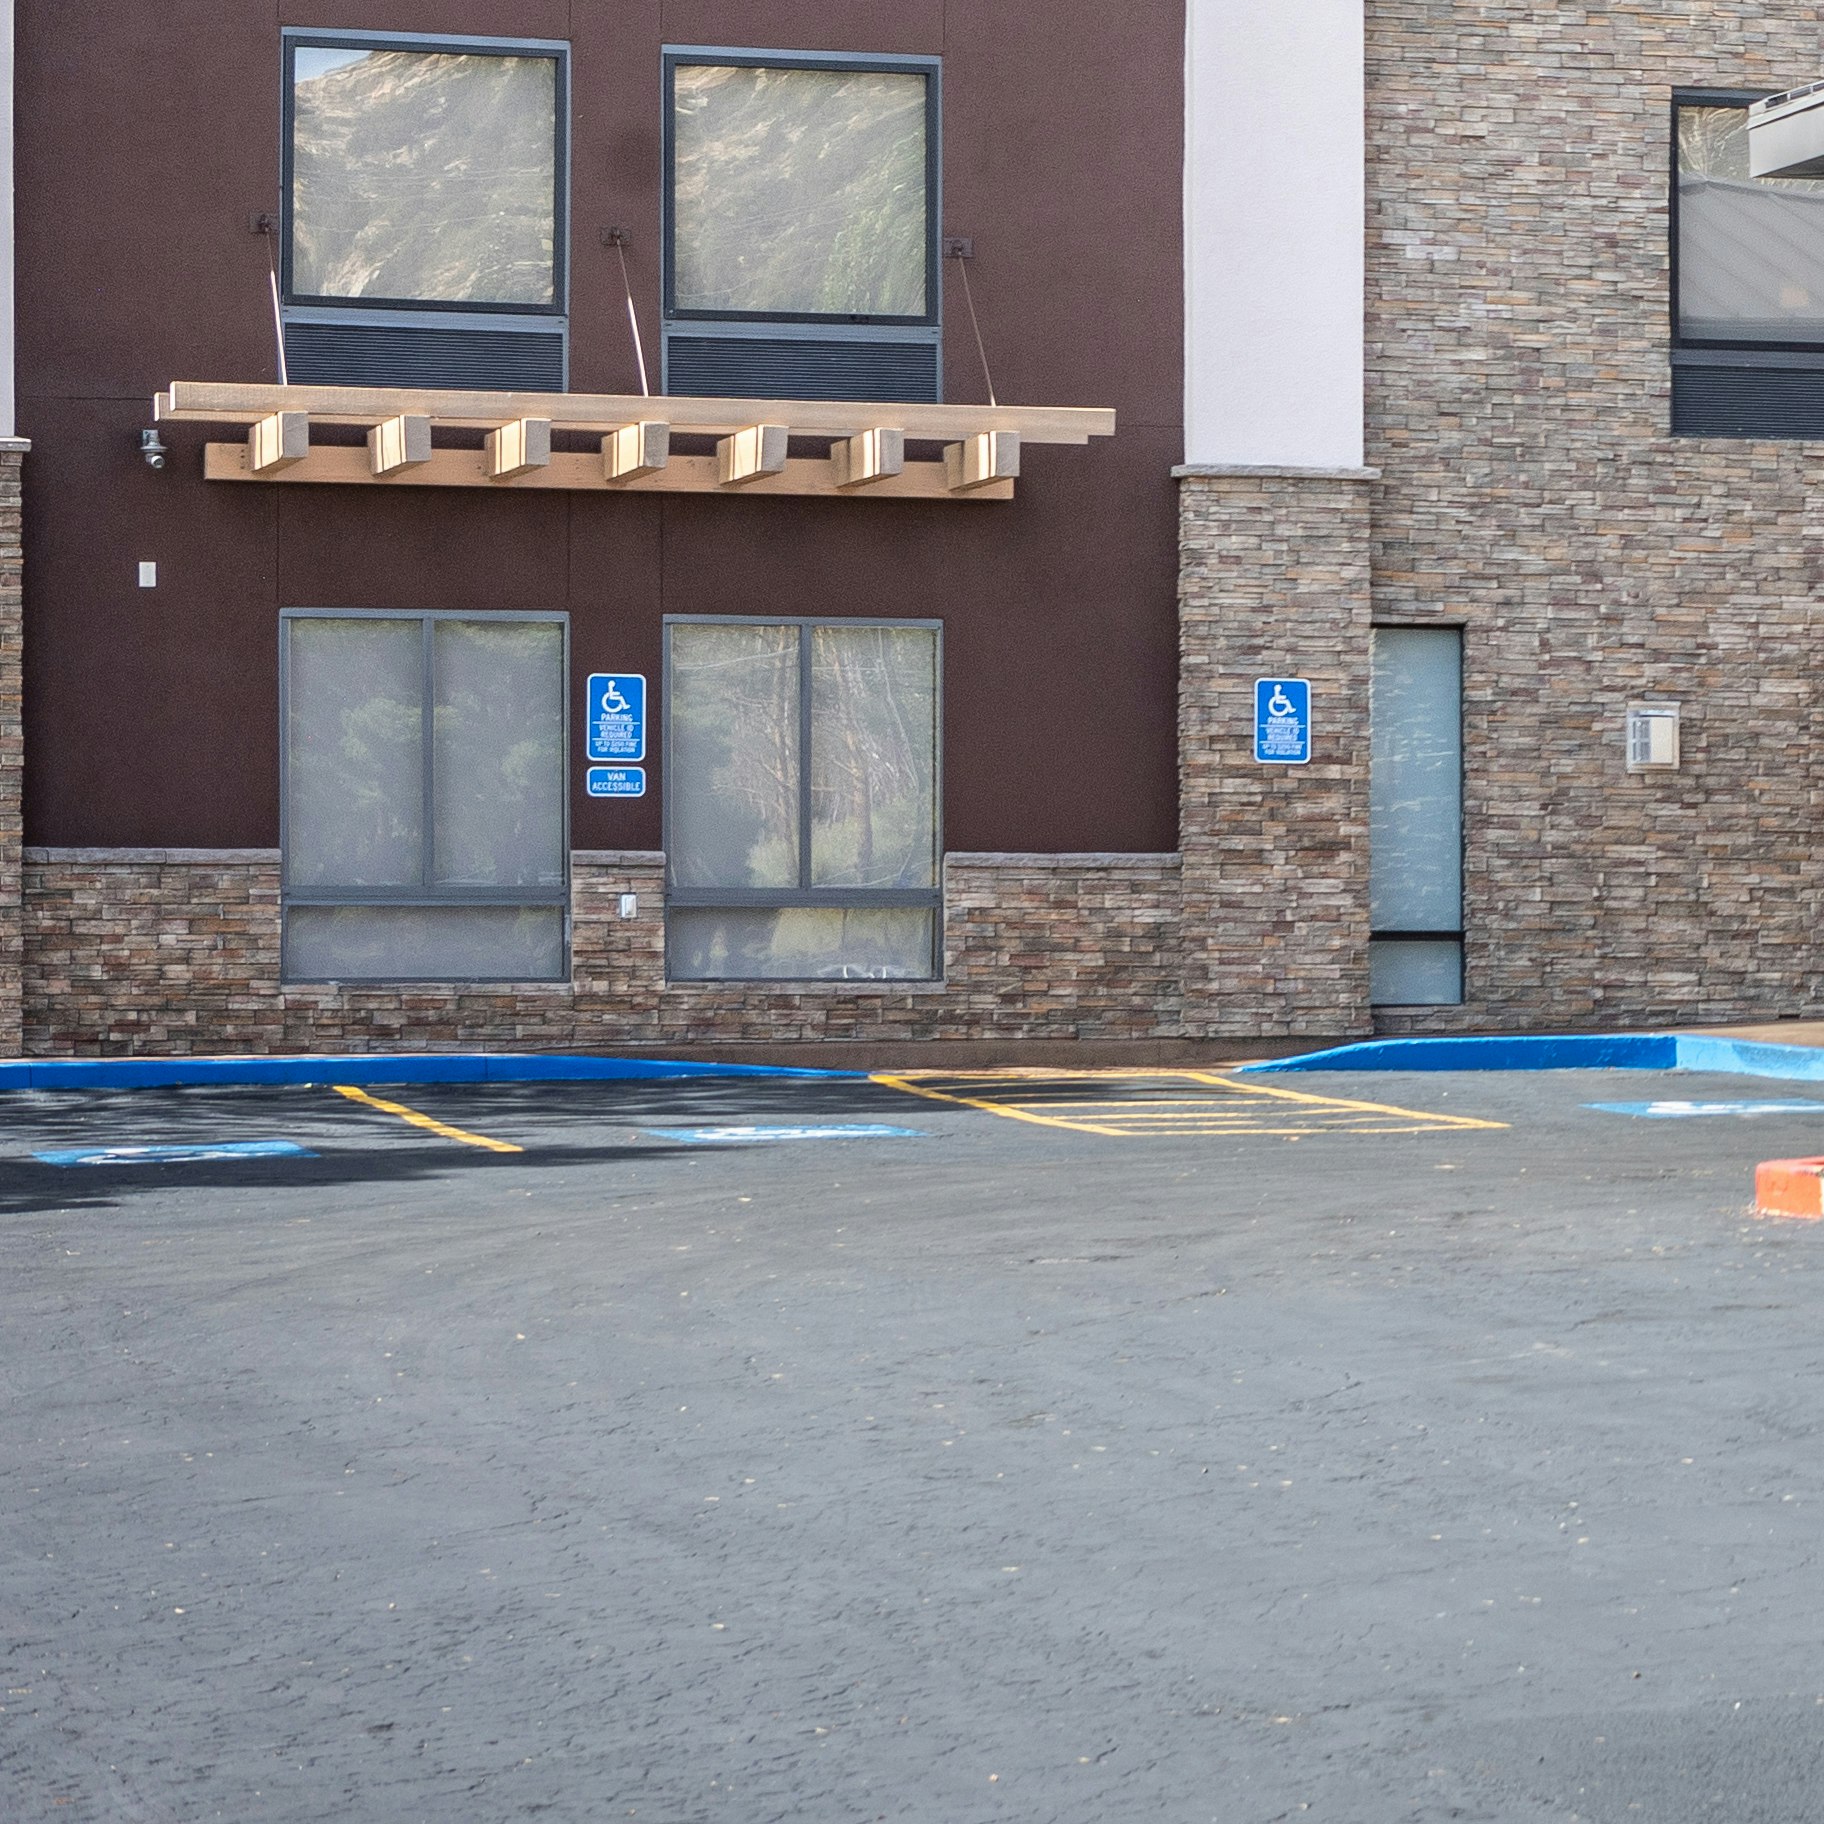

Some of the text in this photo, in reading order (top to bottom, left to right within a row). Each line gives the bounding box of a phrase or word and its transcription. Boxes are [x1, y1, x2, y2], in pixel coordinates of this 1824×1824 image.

[601, 713, 633, 722] PARKING
[1267, 716, 1299, 725] PARKING
[607, 772, 626, 781] VAN
[592, 781, 640, 792] ACCESSIBLE
